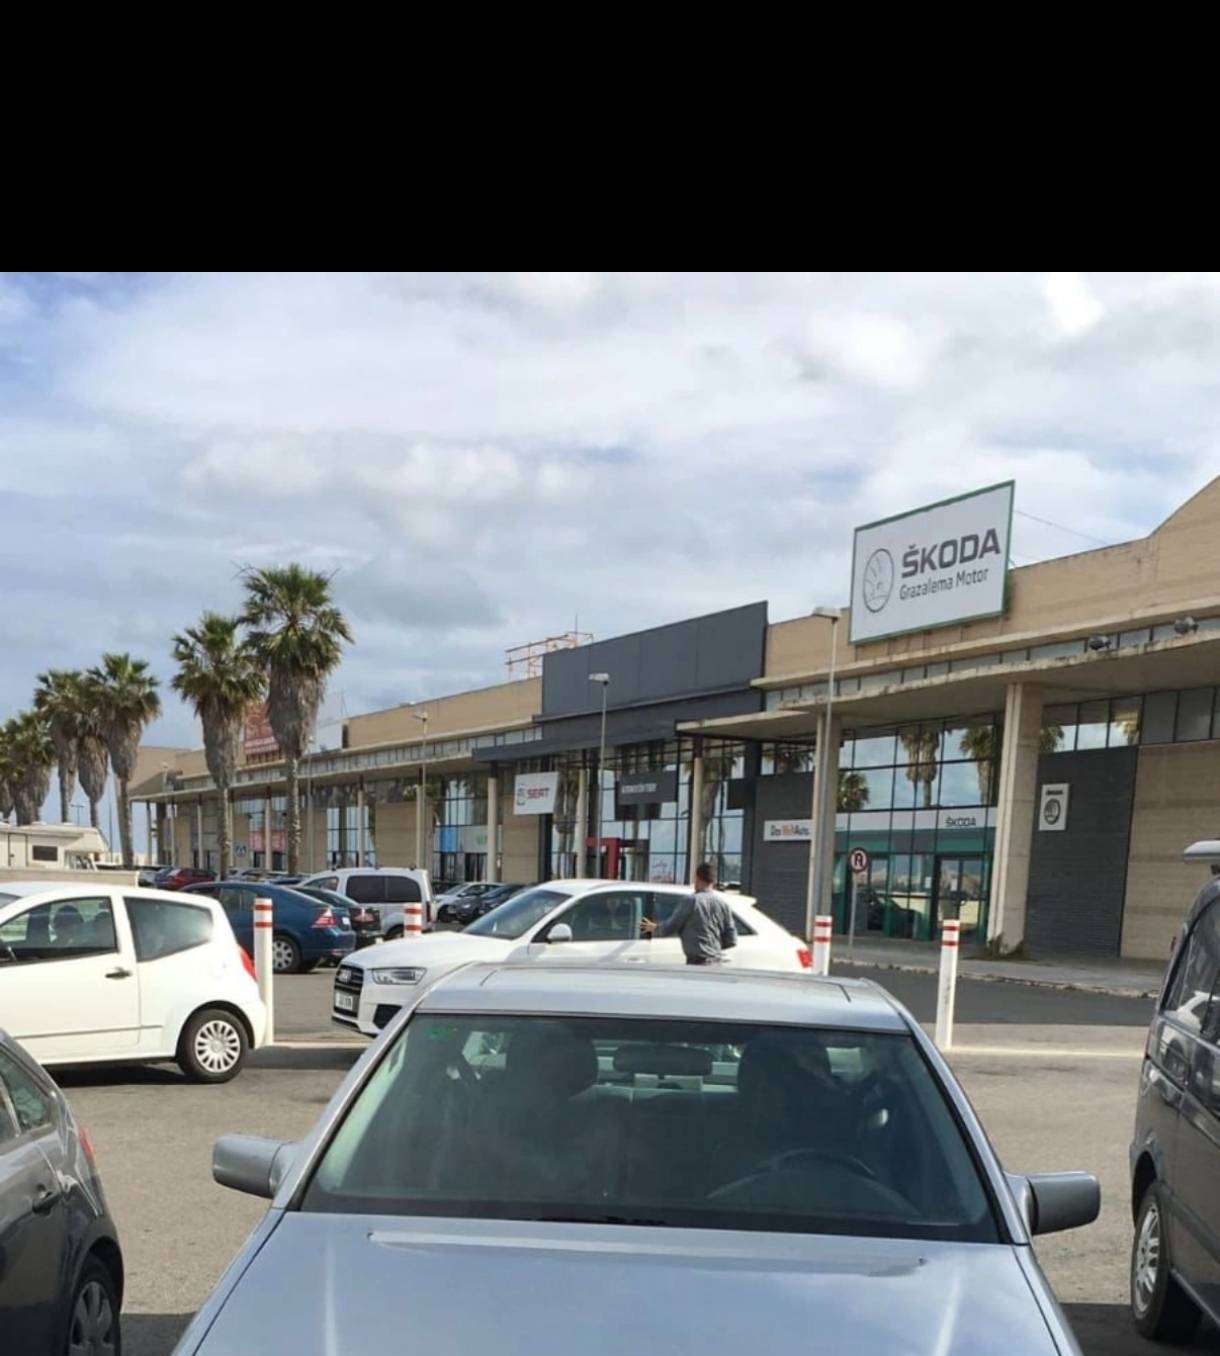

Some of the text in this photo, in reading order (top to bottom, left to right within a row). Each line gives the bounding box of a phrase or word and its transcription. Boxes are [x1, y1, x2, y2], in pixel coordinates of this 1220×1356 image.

[901, 528, 1001, 579] ŠKODA
[900, 568, 989, 601] Grazalema Motor
[527, 787, 550, 799] SEAT
